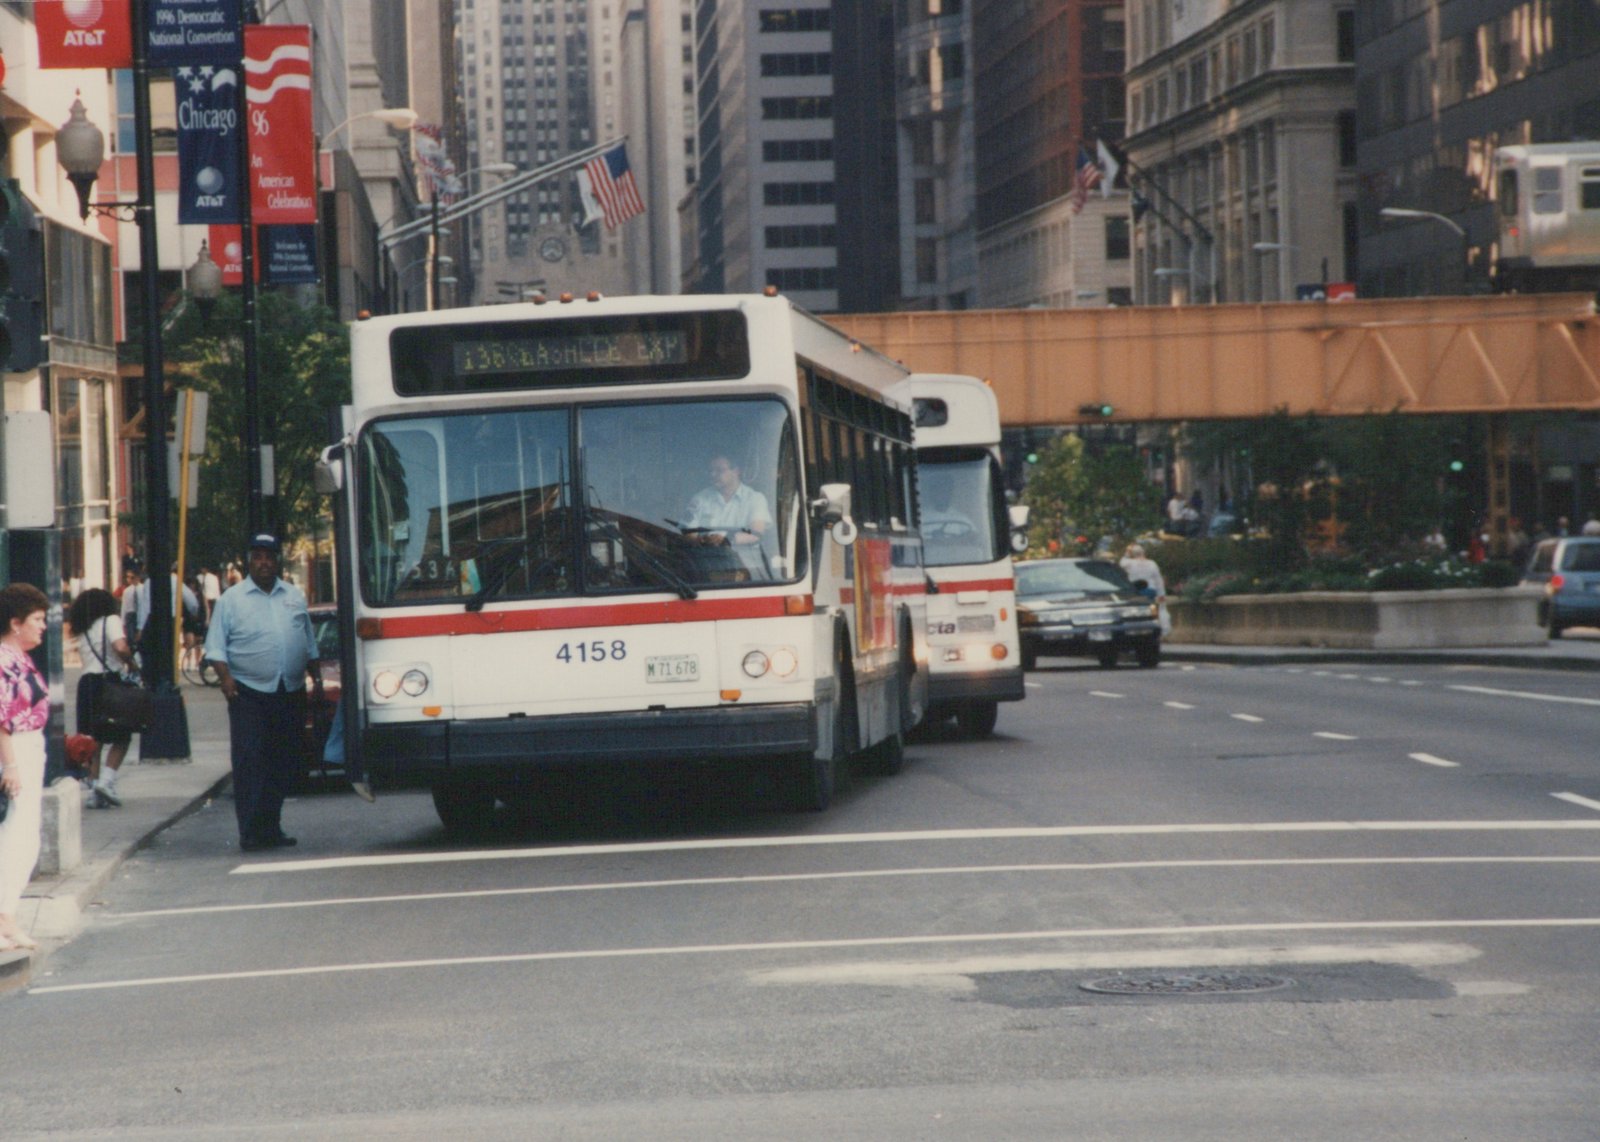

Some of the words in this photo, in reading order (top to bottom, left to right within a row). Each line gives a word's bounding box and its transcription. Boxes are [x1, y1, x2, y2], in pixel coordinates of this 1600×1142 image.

[156, 9, 175, 25] 1996
[177, 8, 225, 24] Democratic
[63, 29, 107, 46] AT&T
[148, 26, 184, 46] National
[186, 29, 235, 44] Convention
[178, 97, 237, 136] Chicago
[258, 173, 295, 188] American
[195, 194, 227, 208] AT&T
[267, 190, 313, 209] Celebration
[556, 640, 627, 664] 4158
[659, 662, 672, 676] 71
[675, 661, 697, 675] 678
